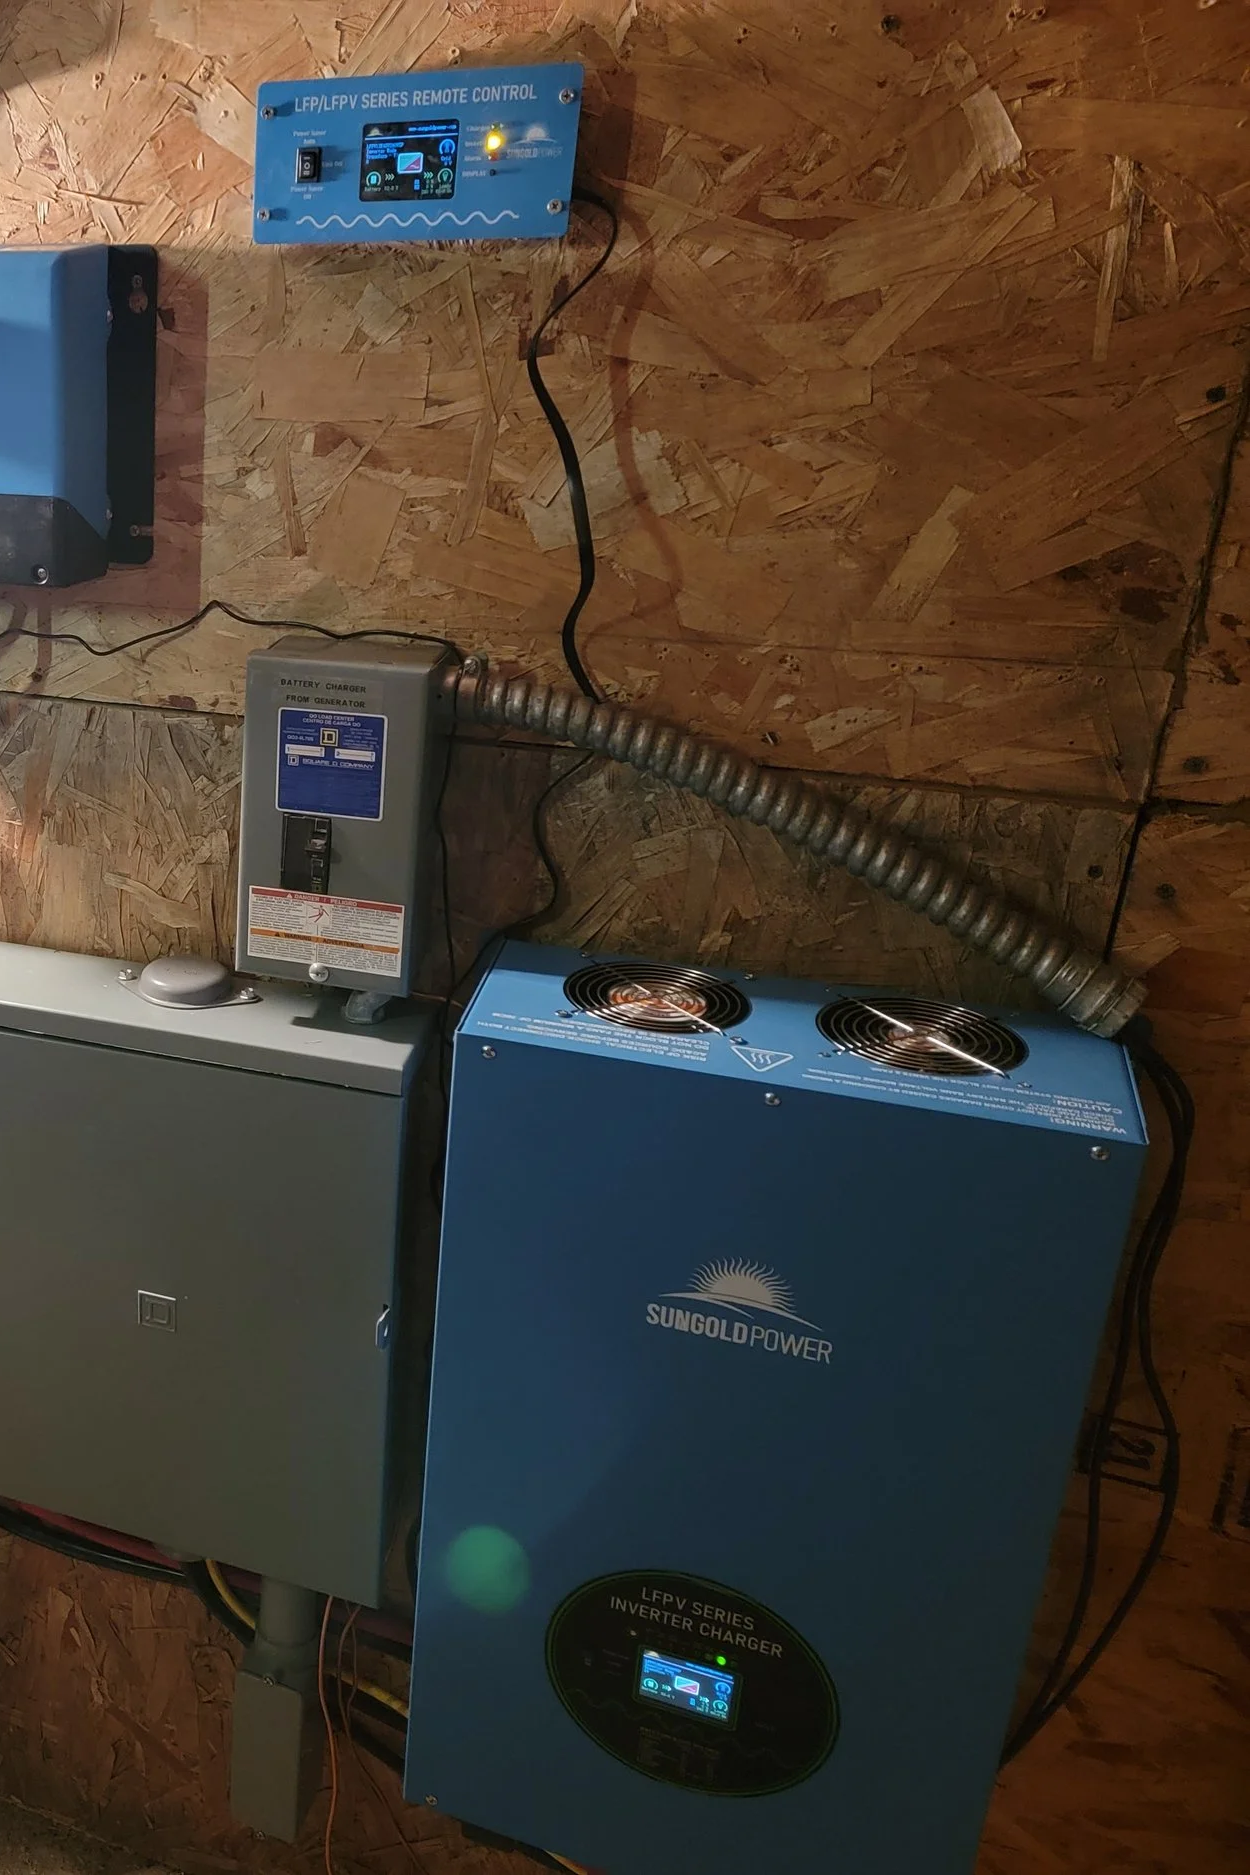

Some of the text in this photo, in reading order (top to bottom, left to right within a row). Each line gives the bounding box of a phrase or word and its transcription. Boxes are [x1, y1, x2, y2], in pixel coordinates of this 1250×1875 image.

[294, 84, 537, 114] LFP/LFPV SERIES REMOTE CONTROL
[280, 678, 367, 694] BATTERY CHARGER
[286, 694, 365, 708] FROM GENERATOR
[340, 761, 374, 769] COMPANY
[293, 894, 320, 902] DANGER
[330, 899, 358, 907] PELIGRO
[284, 932, 312, 942] WARNING
[322, 939, 365, 949] ADVERTENCIA
[646, 1303, 833, 1365] SUNGOLDPOWER
[641, 1586, 755, 1631] LFPV SERIES
[610, 1596, 693, 1632] INVERTER
[700, 1622, 783, 1658] CHARGER
